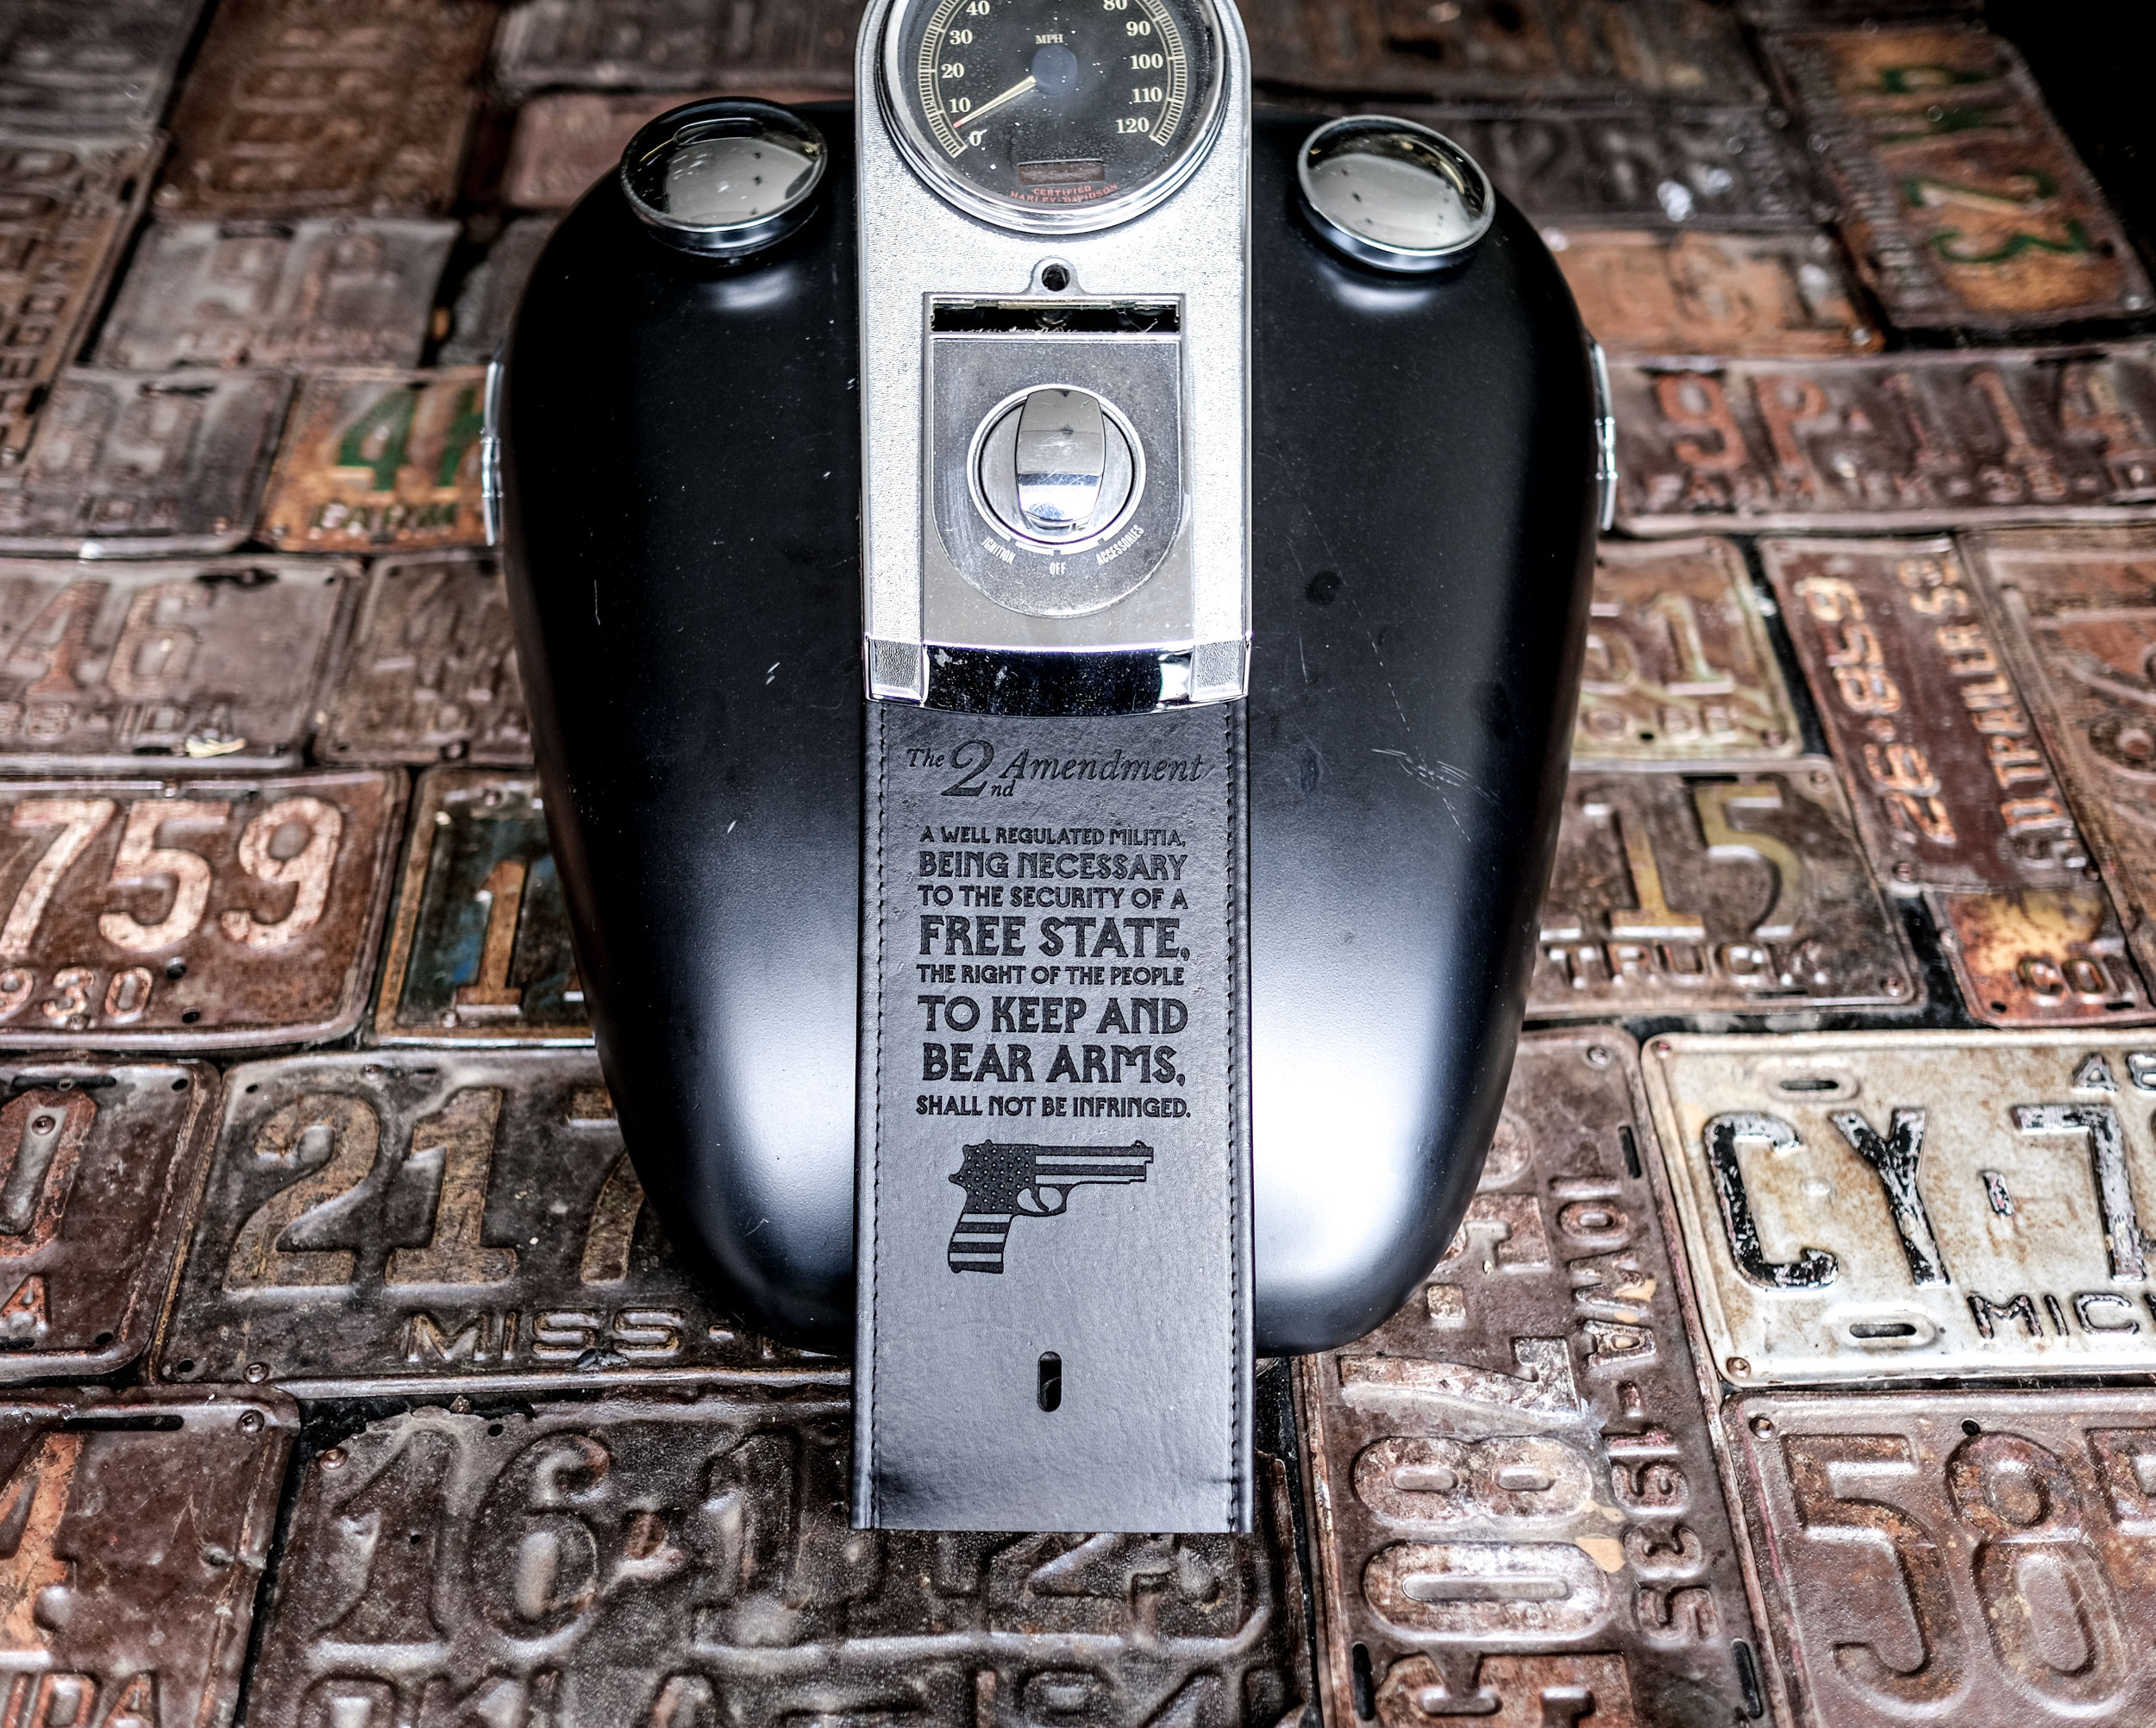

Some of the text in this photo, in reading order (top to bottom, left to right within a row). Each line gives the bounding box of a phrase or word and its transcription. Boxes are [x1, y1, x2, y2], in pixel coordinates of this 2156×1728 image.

[966, 0, 991, 16] 40
[1103, 0, 1128, 10] 80
[950, 29, 973, 44] 30
[1035, 34, 1063, 44] MPH
[1125, 21, 1150, 36] 90
[941, 63, 965, 78] 20
[1130, 53, 1163, 69] 100
[950, 97, 971, 113] 10
[1131, 87, 1163, 103] 110
[1116, 117, 1150, 134] 120
[969, 131, 982, 147] 0
[1033, 185, 1093, 197] CERTIFIED
[981, 536, 1016, 565] IGNITION
[1095, 524, 1144, 566] ACCESSORIES
[1050, 562, 1066, 575] OFF
[907, 748, 943, 768] The
[999, 748, 1205, 782] Amendment
[919, 826, 1186, 847] A WELL REGULATED MILITIA,
[918, 851, 1188, 880] BEING NECESSARY
[1539, 780, 1809, 940] 15
[0, 795, 343, 951] 759
[918, 885, 1188, 910] TO THE SECURITY OF A
[919, 915, 1190, 961] FREE STATE,
[917, 964, 1184, 986] THE RIGHT OF THE PEOPLE
[918, 995, 1188, 1035] TO KEEP AND
[922, 1042, 1186, 1086] BEAR ARMS,
[916, 1095, 1192, 1118] SHALL NOT BE INFRINGED.
[1703, 1105, 2156, 1293] CY-7
